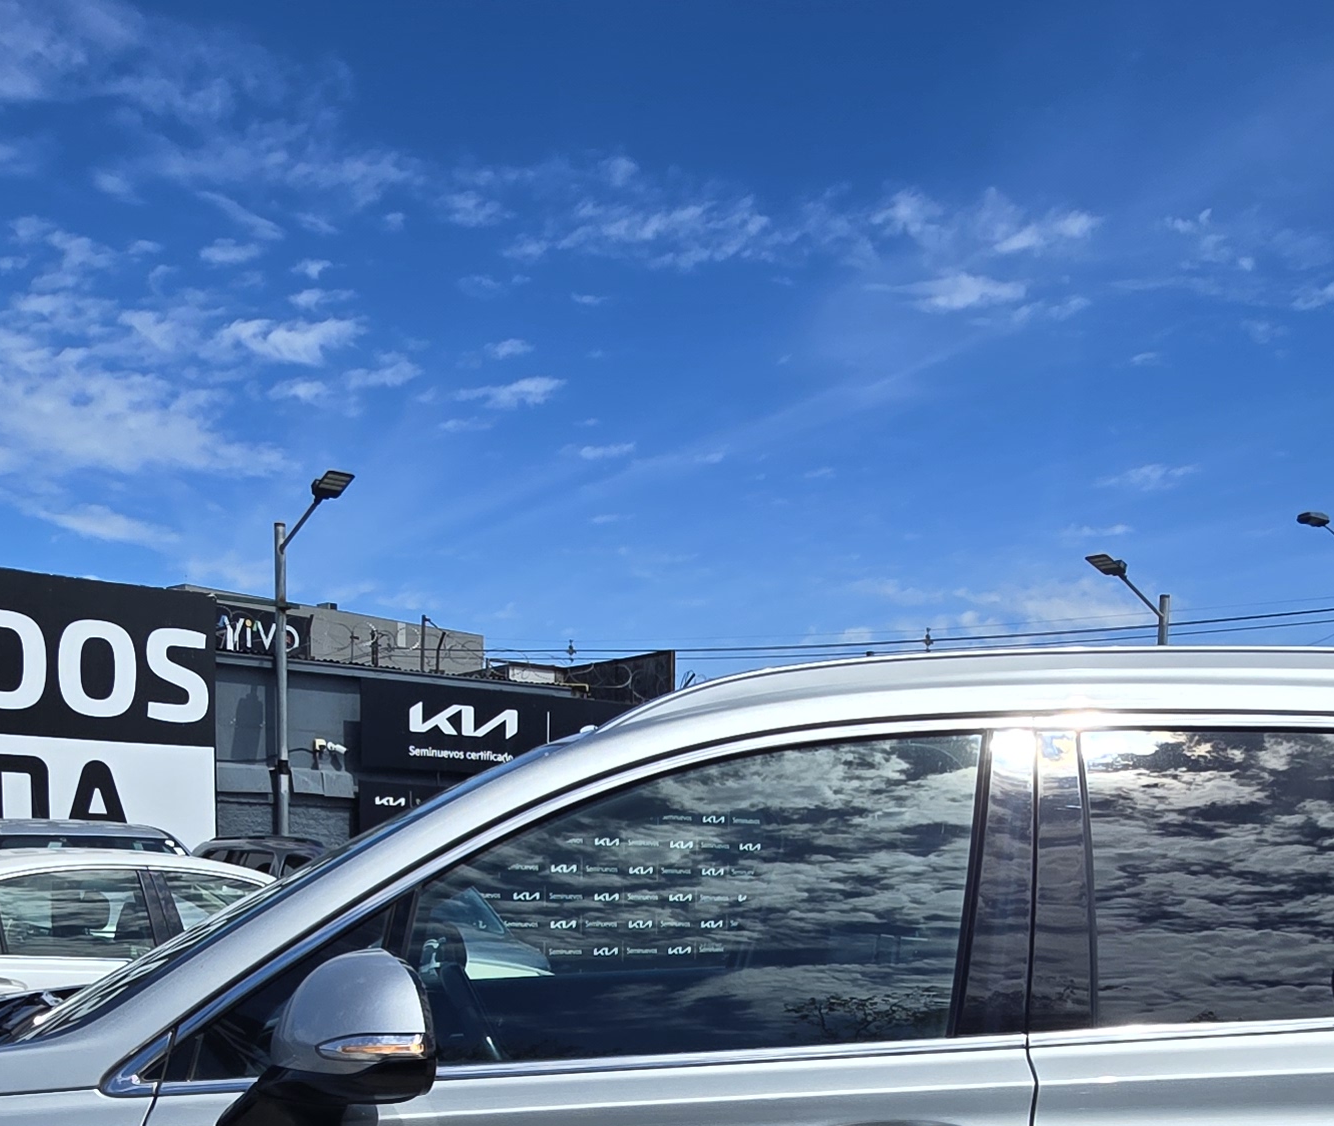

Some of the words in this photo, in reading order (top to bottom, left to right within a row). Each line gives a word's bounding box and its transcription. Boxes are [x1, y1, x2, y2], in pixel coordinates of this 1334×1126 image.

[409, 701, 518, 740] KIA
[408, 745, 465, 760] Seminuevos
[375, 797, 406, 809] KIA
